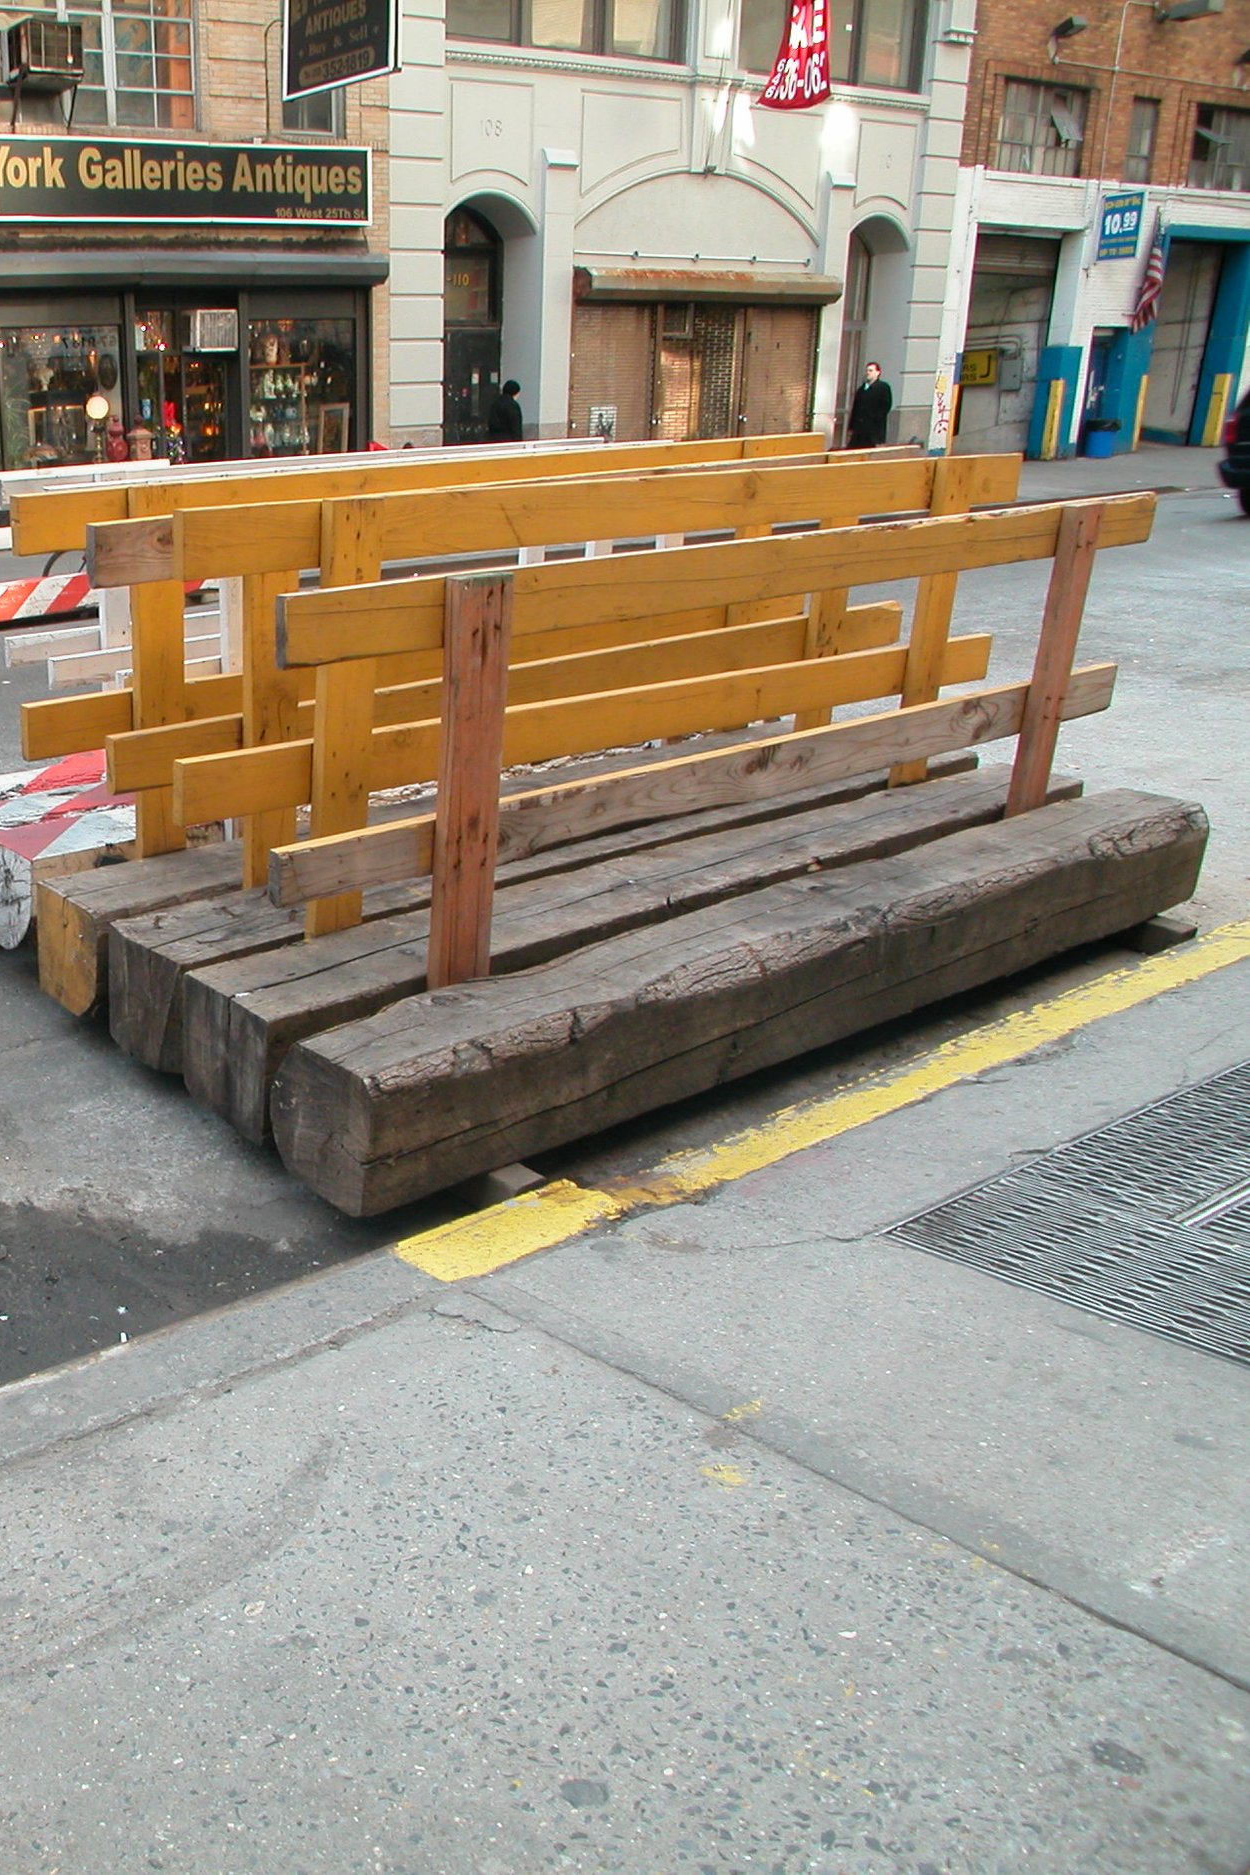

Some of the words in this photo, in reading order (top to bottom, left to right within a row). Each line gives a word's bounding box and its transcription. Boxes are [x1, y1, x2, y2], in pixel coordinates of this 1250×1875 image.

[305, 0, 367, 37] ANTIQUES
[78, 146, 223, 192] Galleries
[232, 152, 363, 204] Antiques
[274, 206, 293, 219] 106
[295, 206, 322, 219] West
[324, 207, 350, 220] 25Th
